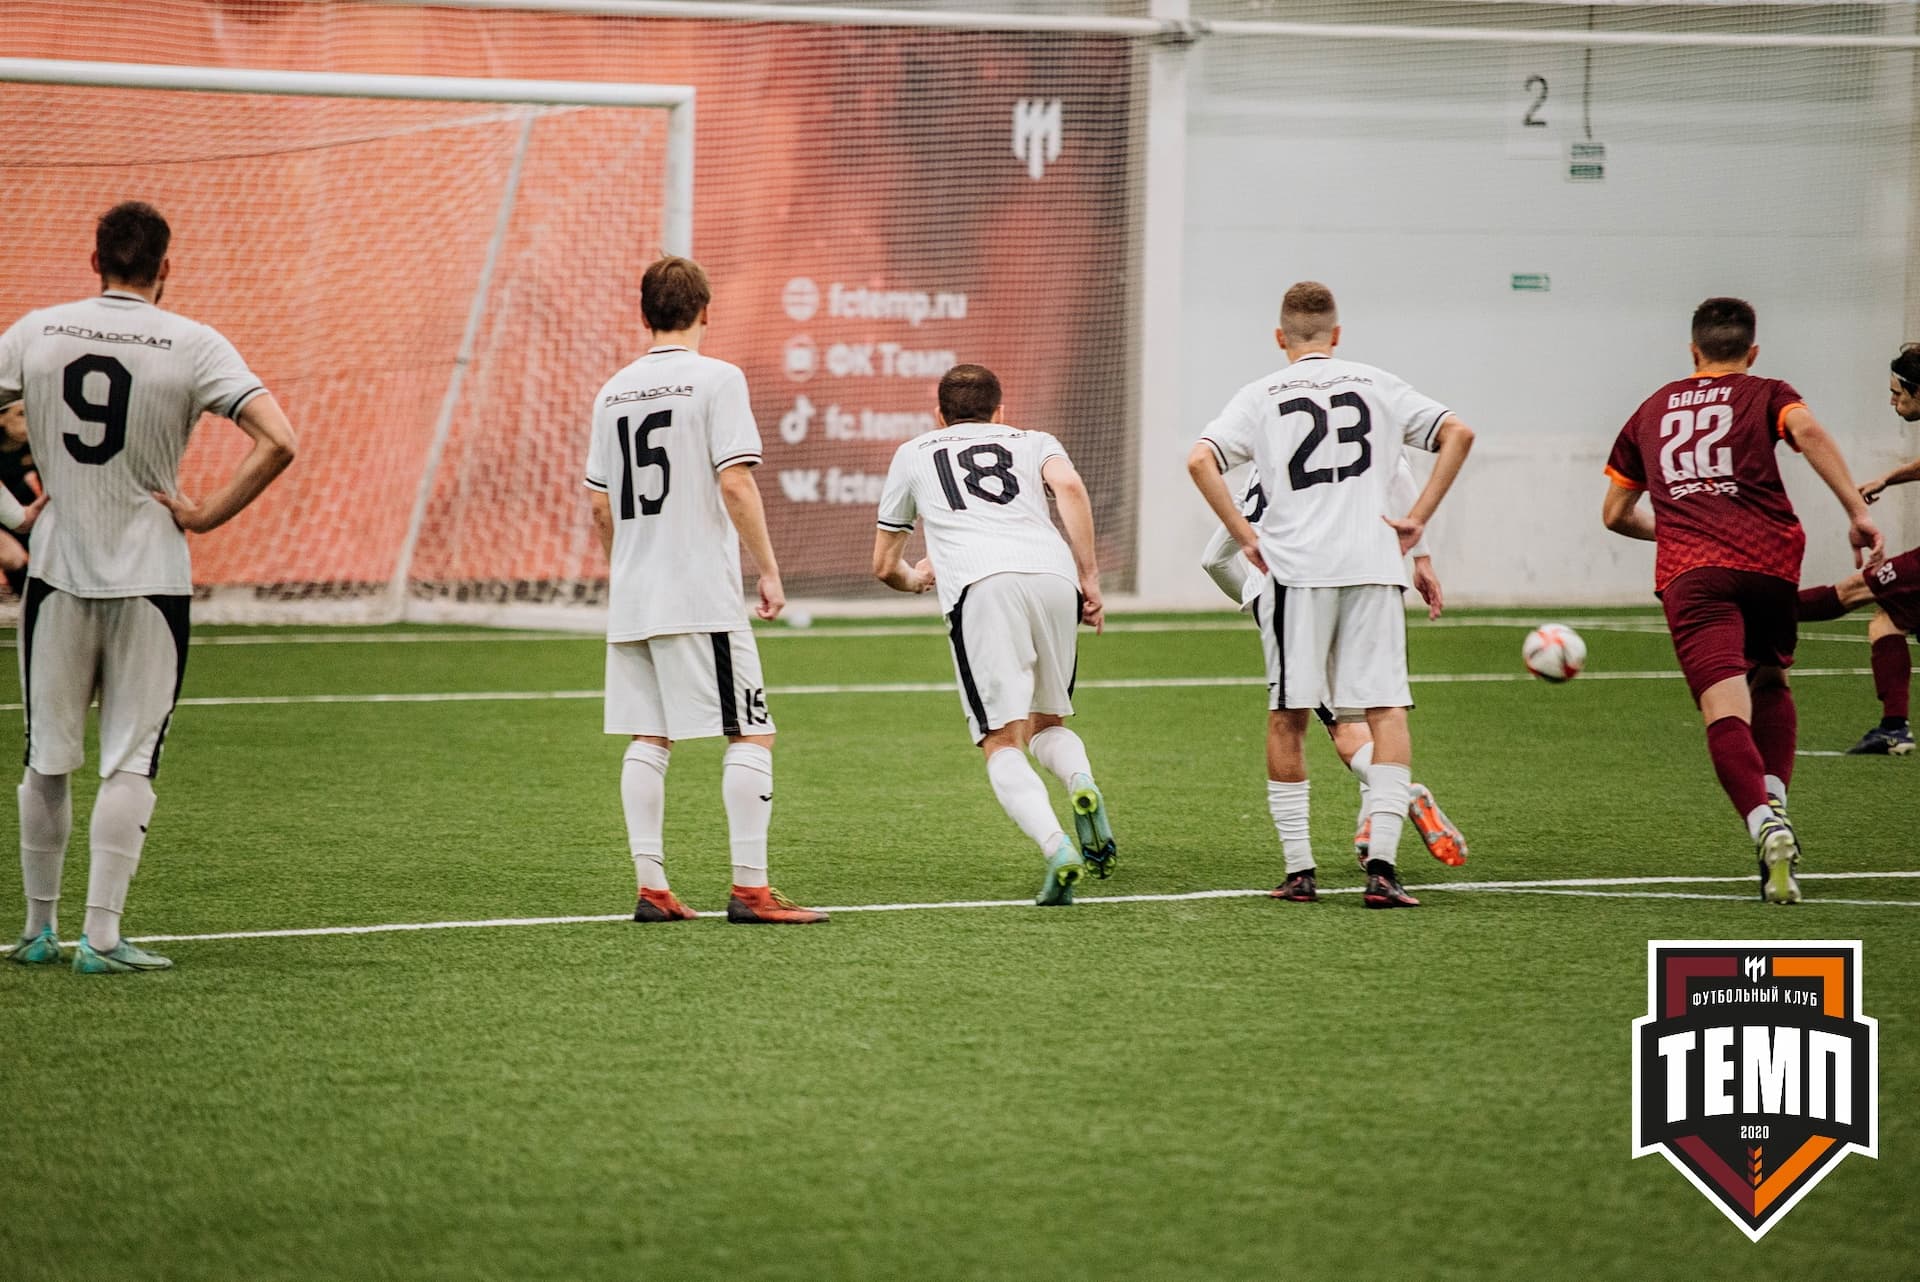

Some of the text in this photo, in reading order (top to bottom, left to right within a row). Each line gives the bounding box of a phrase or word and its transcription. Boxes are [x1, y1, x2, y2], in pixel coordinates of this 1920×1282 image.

[1523, 75, 1548, 127] 2
[829, 282, 968, 327] fctemp.ru
[62, 353, 132, 465] 9
[1667, 386, 1733, 409] БАБИЧ
[617, 409, 672, 520] 15
[1278, 391, 1371, 491] 23
[1660, 404, 1734, 484] 22
[933, 443, 1020, 511] 18
[745, 688, 768, 725] 15
